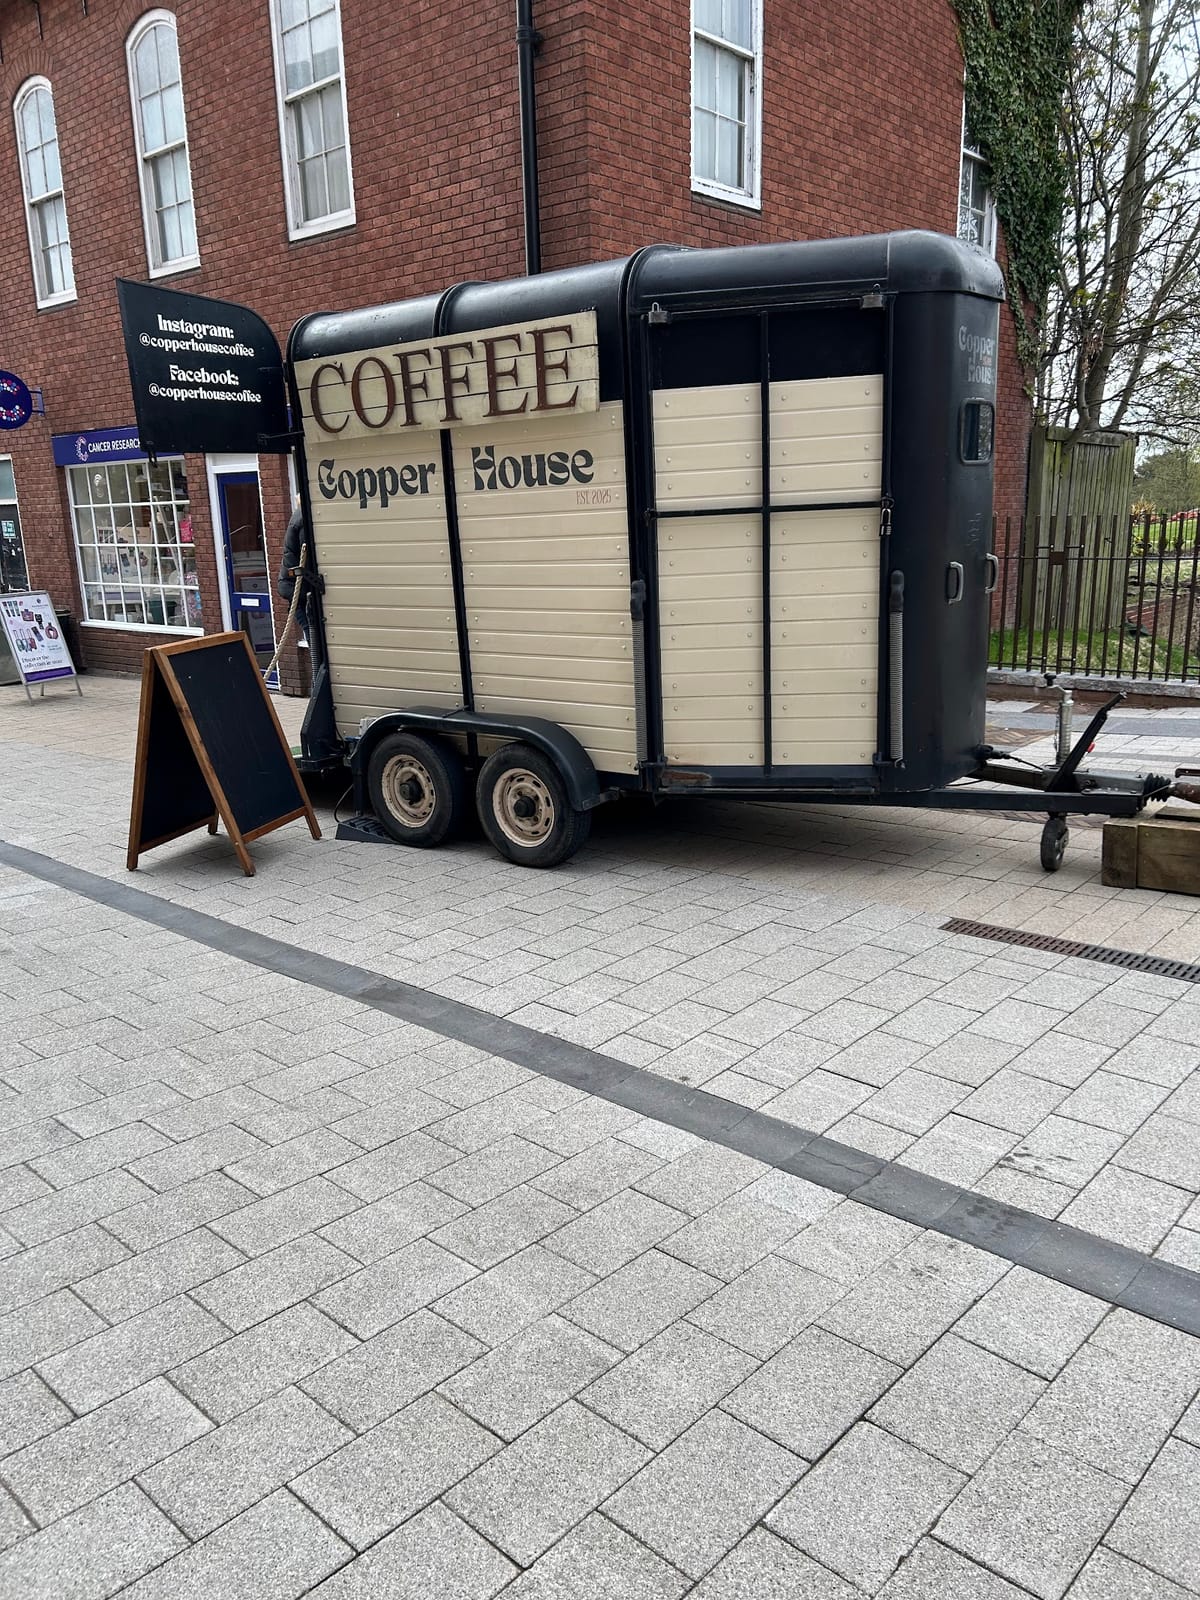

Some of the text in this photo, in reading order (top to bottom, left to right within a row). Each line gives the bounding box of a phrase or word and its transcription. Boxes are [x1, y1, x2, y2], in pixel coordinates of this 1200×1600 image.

[157, 314, 235, 339] Instagram:
[139, 332, 255, 357] @copperhousecoffee
[959, 325, 995, 362] Copper
[169, 364, 239, 386] Facebook:
[310, 324, 579, 434] COFFEE
[148, 382, 262, 403] @copperhousecoffee
[88, 442, 112, 452] CANCER
[318, 445, 594, 509] Copper House
[591, 488, 612, 505] 2025
